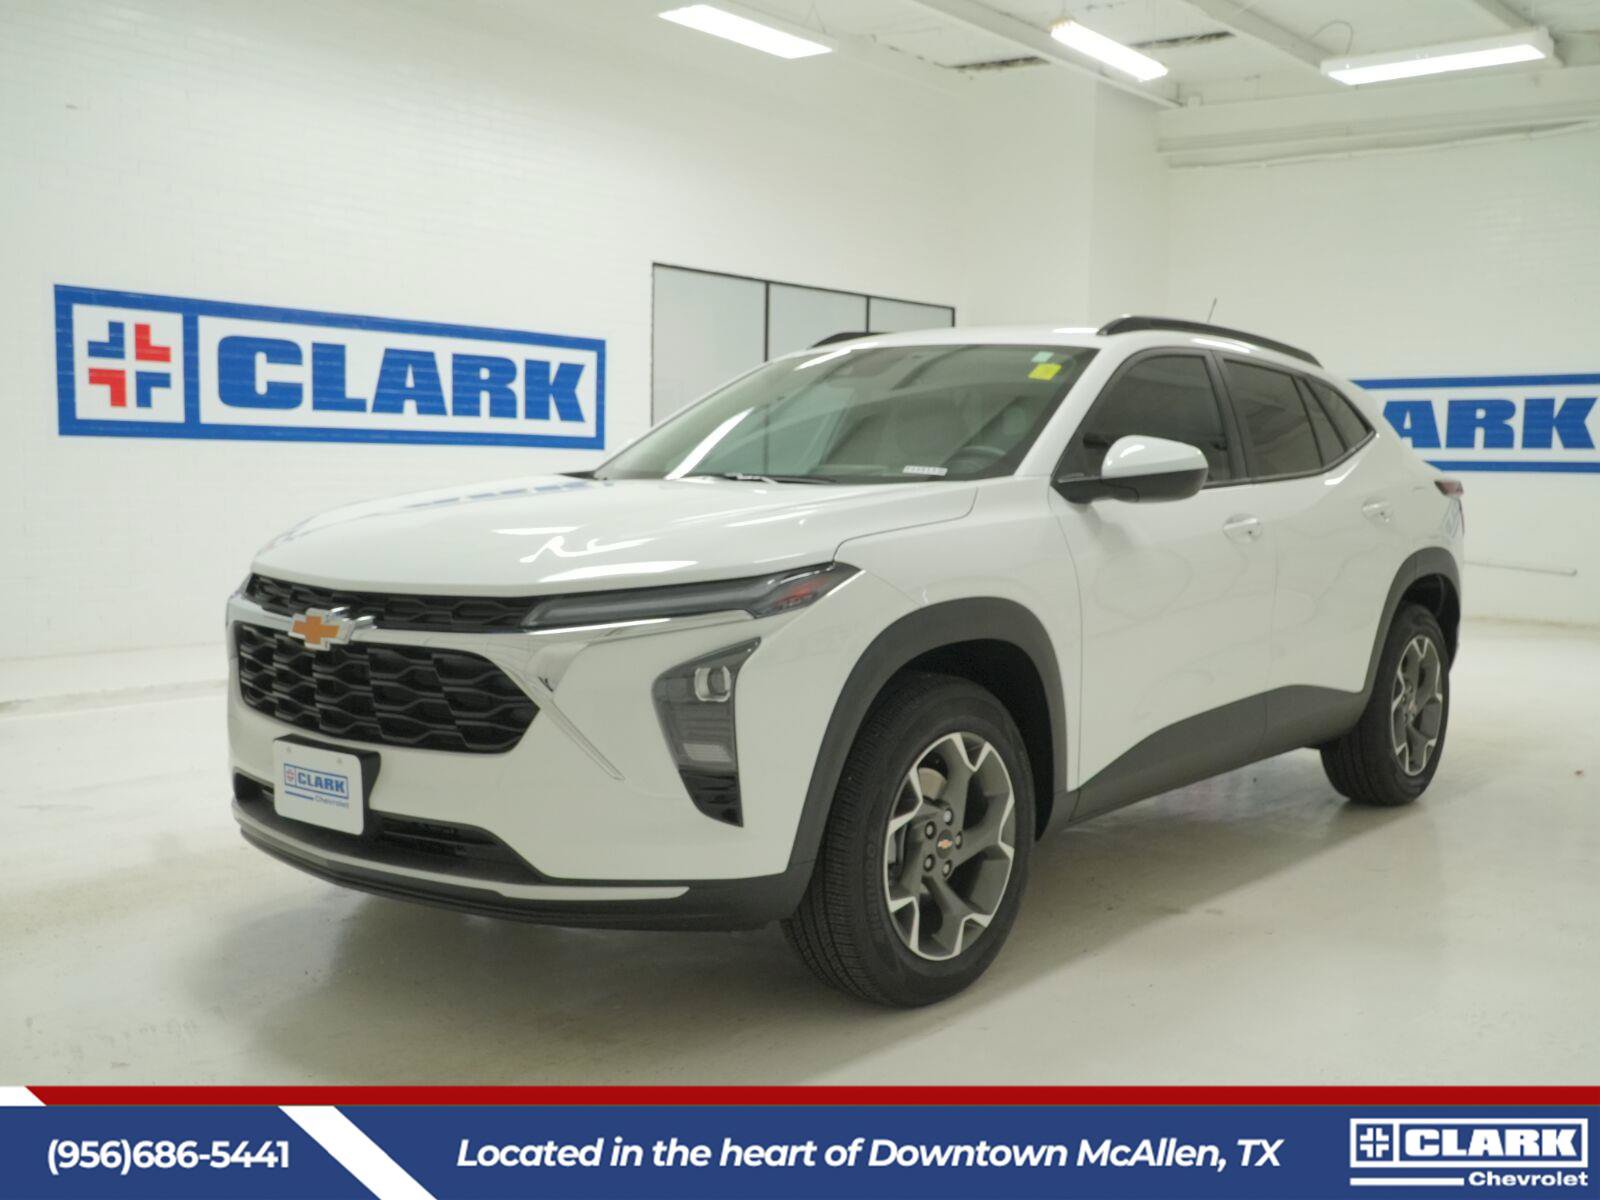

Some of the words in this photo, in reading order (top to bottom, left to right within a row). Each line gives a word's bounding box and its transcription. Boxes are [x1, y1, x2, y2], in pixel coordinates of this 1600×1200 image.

[217, 335, 587, 423] CLARK
[1383, 397, 1598, 450] ARK
[297, 772, 345, 794] CLARK
